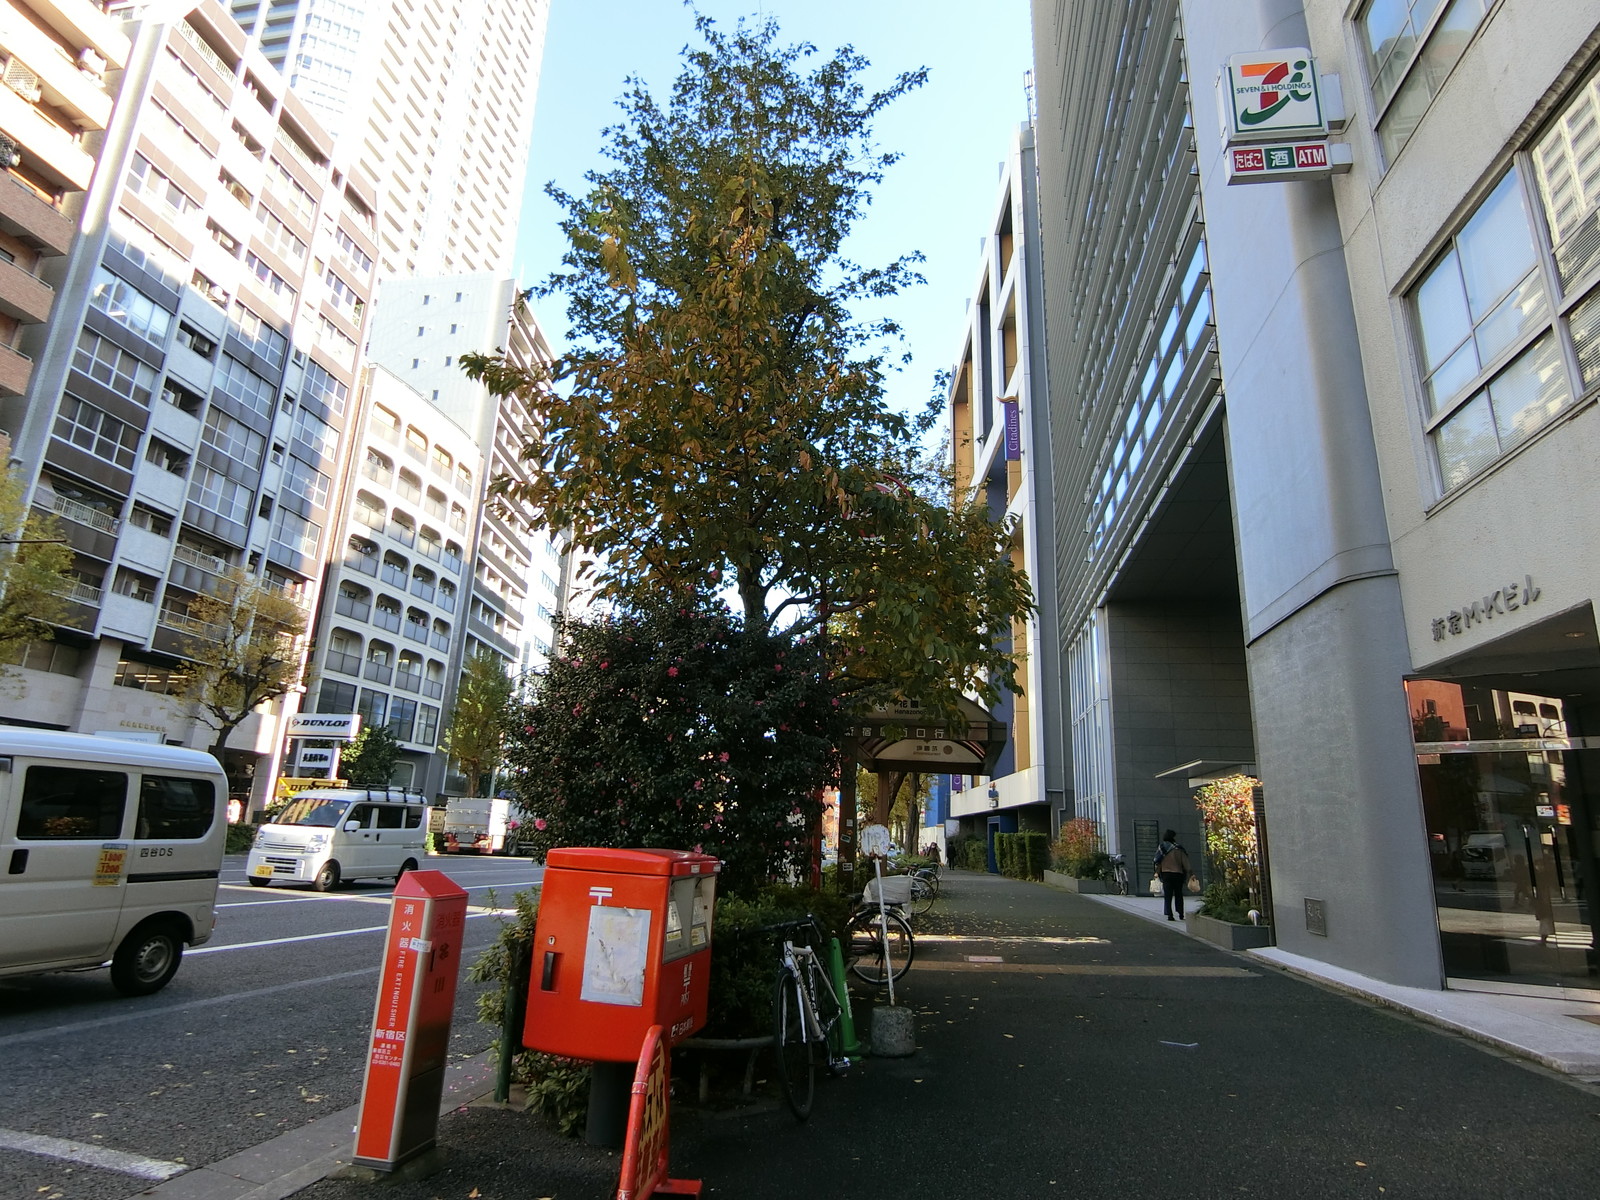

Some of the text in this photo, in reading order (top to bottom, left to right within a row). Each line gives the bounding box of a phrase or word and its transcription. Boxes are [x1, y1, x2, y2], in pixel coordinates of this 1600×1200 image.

[1271, 82, 1312, 92] HOLDINGS
[1235, 153, 1263, 169] たばこ
[1270, 150, 1289, 167] 酒
[1298, 148, 1325, 165] ATM
[1008, 409, 1018, 451] Citadines
[301, 719, 350, 727] DUNLOP
[140, 848, 173, 857] 四谷DS
[399, 903, 415, 948] 消火器
[388, 950, 406, 1028] FIRE EXTINGUISHER
[375, 1029, 406, 1041] 新宿区
